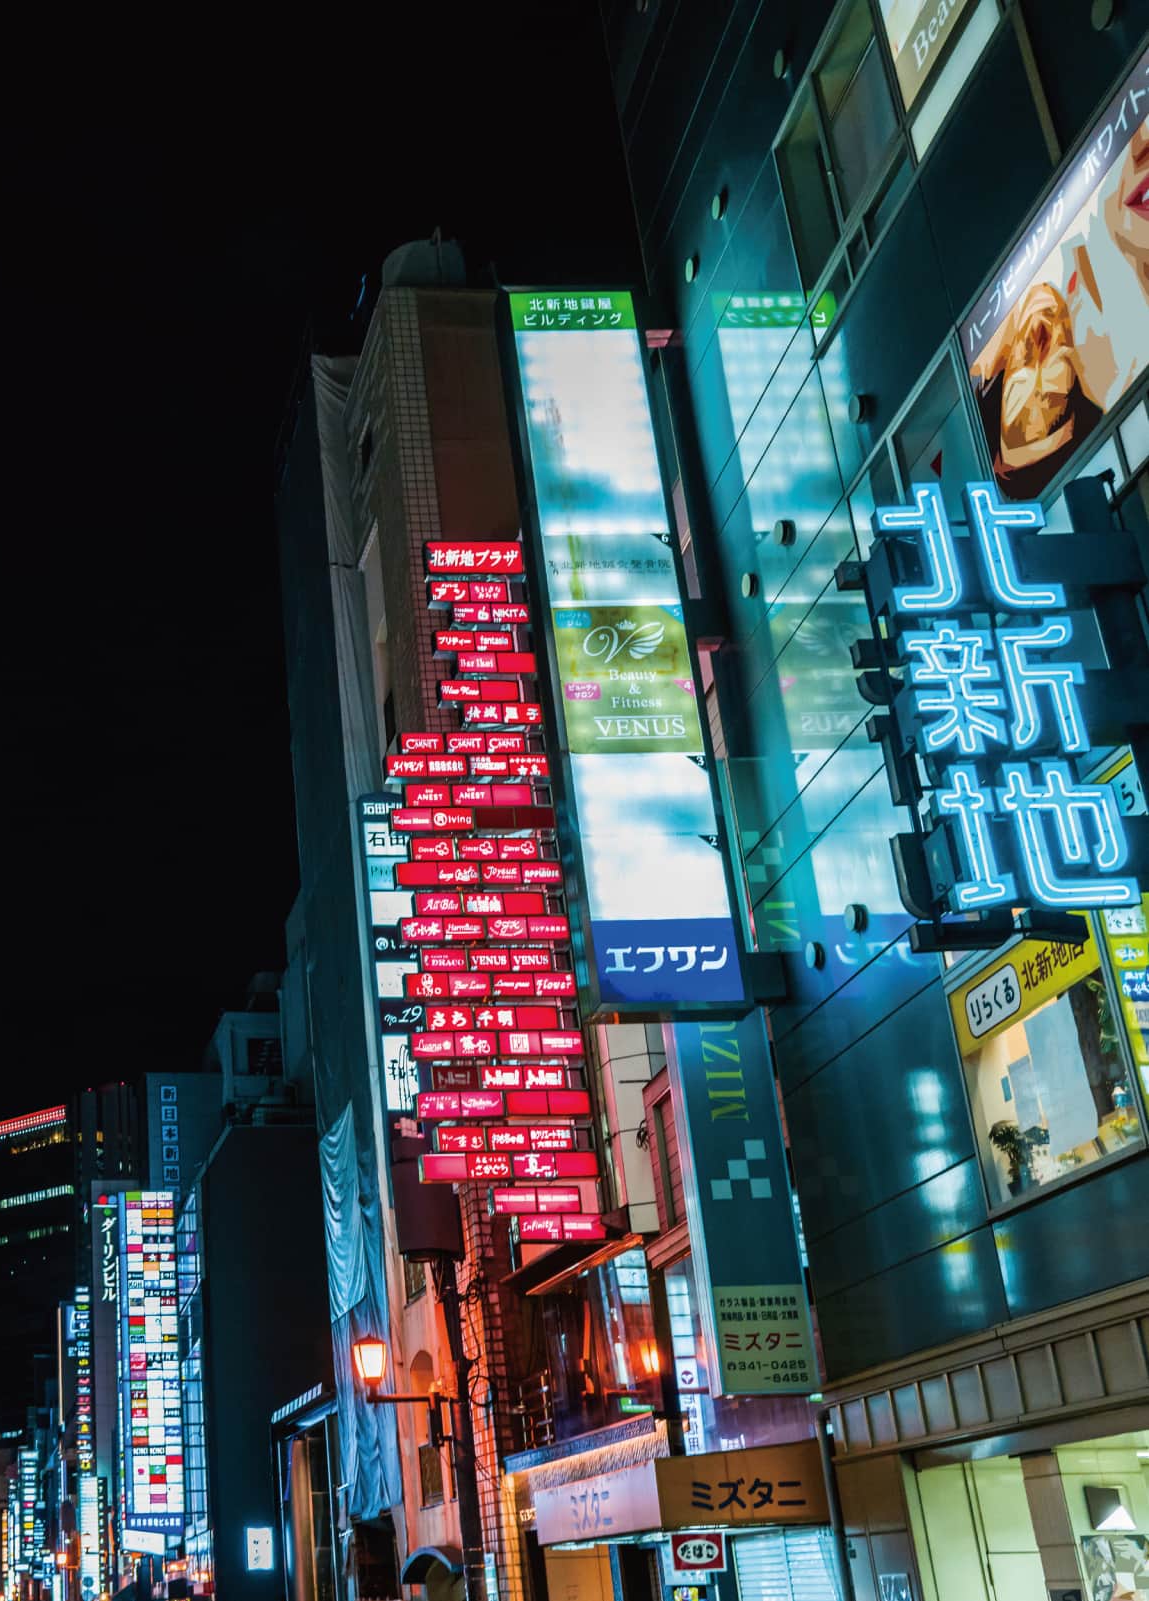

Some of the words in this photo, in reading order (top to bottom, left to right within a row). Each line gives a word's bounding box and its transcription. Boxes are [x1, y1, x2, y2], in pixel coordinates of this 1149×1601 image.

[523, 313, 623, 326] ビルディング
[430, 549, 518, 567] 北新地プラザ
[492, 609, 528, 618] NIKITA
[609, 669, 658, 682] Beauty
[611, 696, 662, 708] Fitness
[871, 480, 1141, 911] 北新地
[594, 717, 687, 737] VENUS
[470, 955, 507, 965] VENUS
[512, 955, 549, 966] VENUS
[605, 945, 728, 975] エフワン
[969, 977, 1015, 1027] りらくる
[100, 1217, 118, 1303] ダーリンビル
[690, 1477, 807, 1511] ミズタニ
